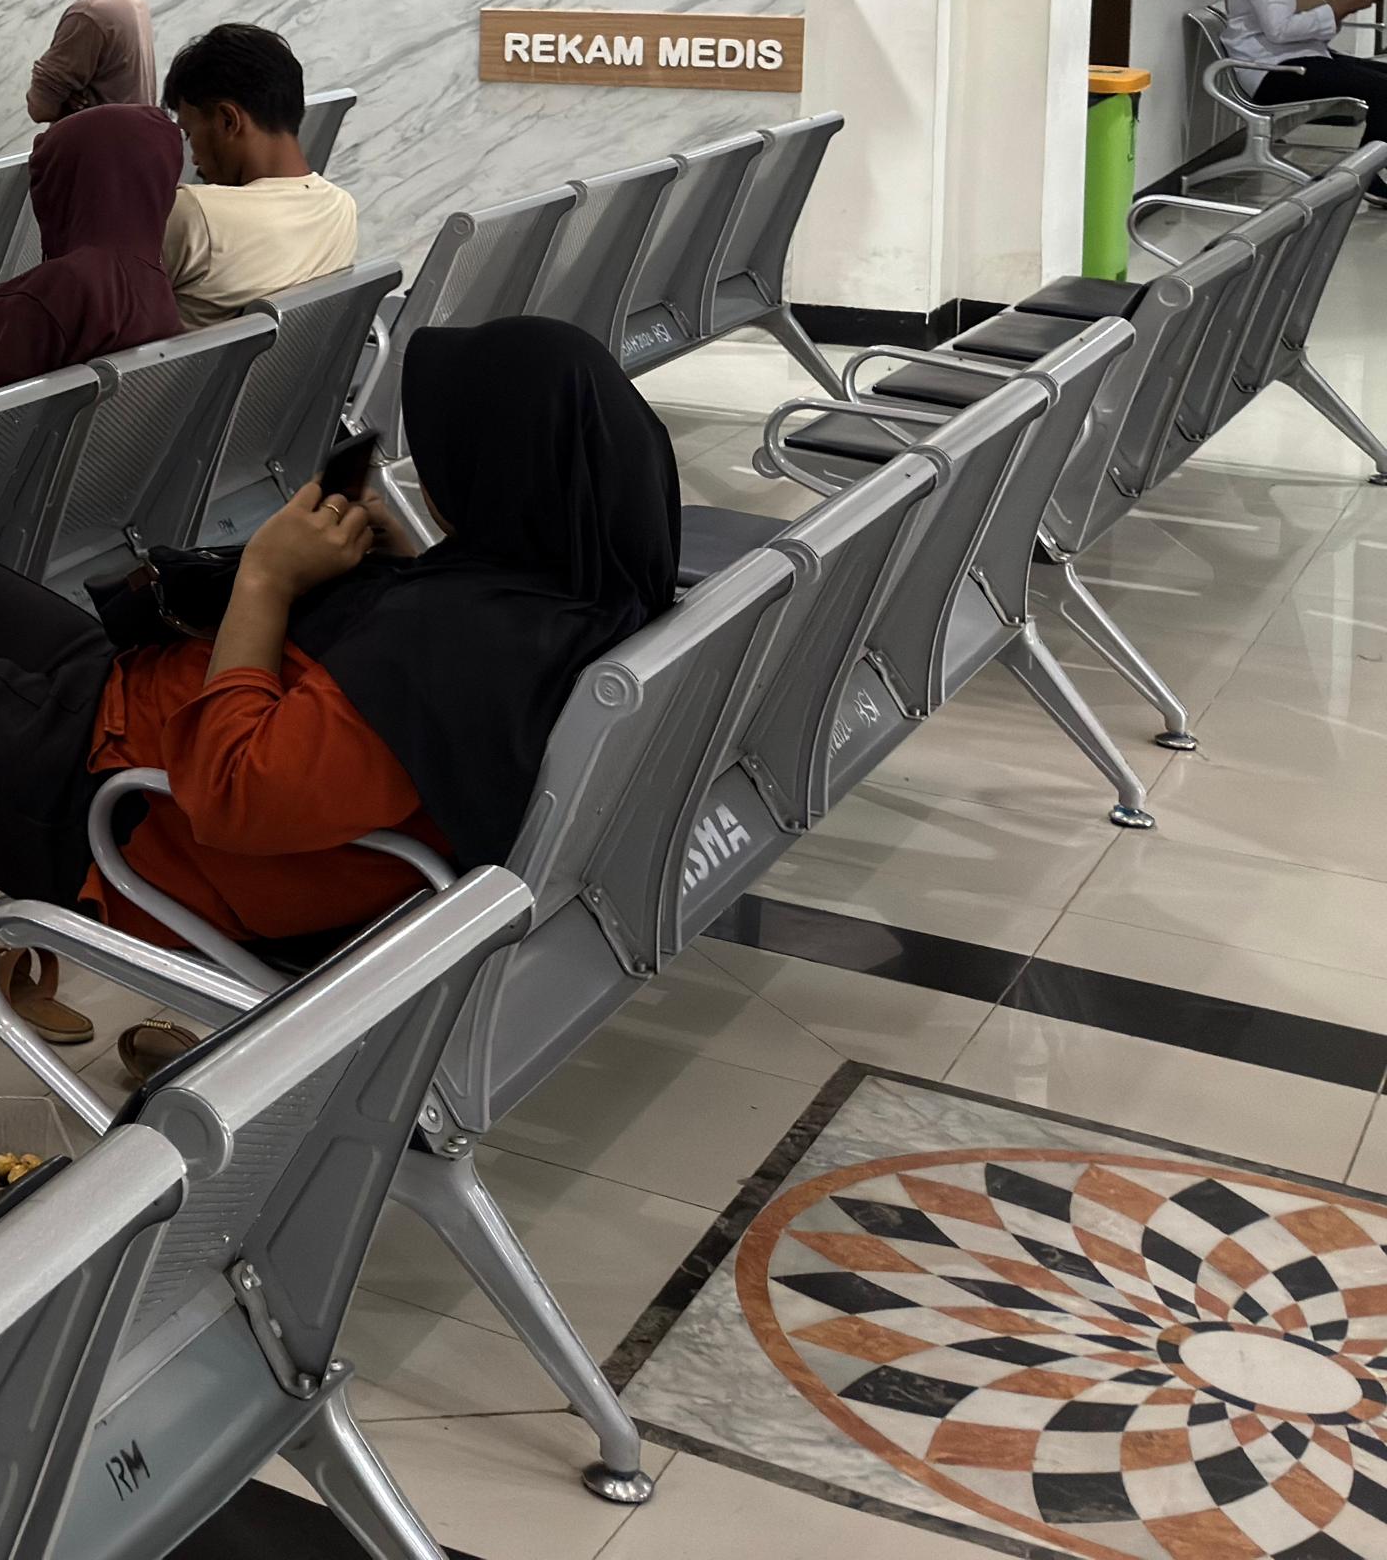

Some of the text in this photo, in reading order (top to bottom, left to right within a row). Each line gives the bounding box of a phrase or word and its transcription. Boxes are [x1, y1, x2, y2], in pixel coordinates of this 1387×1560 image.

[503, 31, 784, 72] REKAM MEDIS
[104, 1438, 151, 1502] RM
